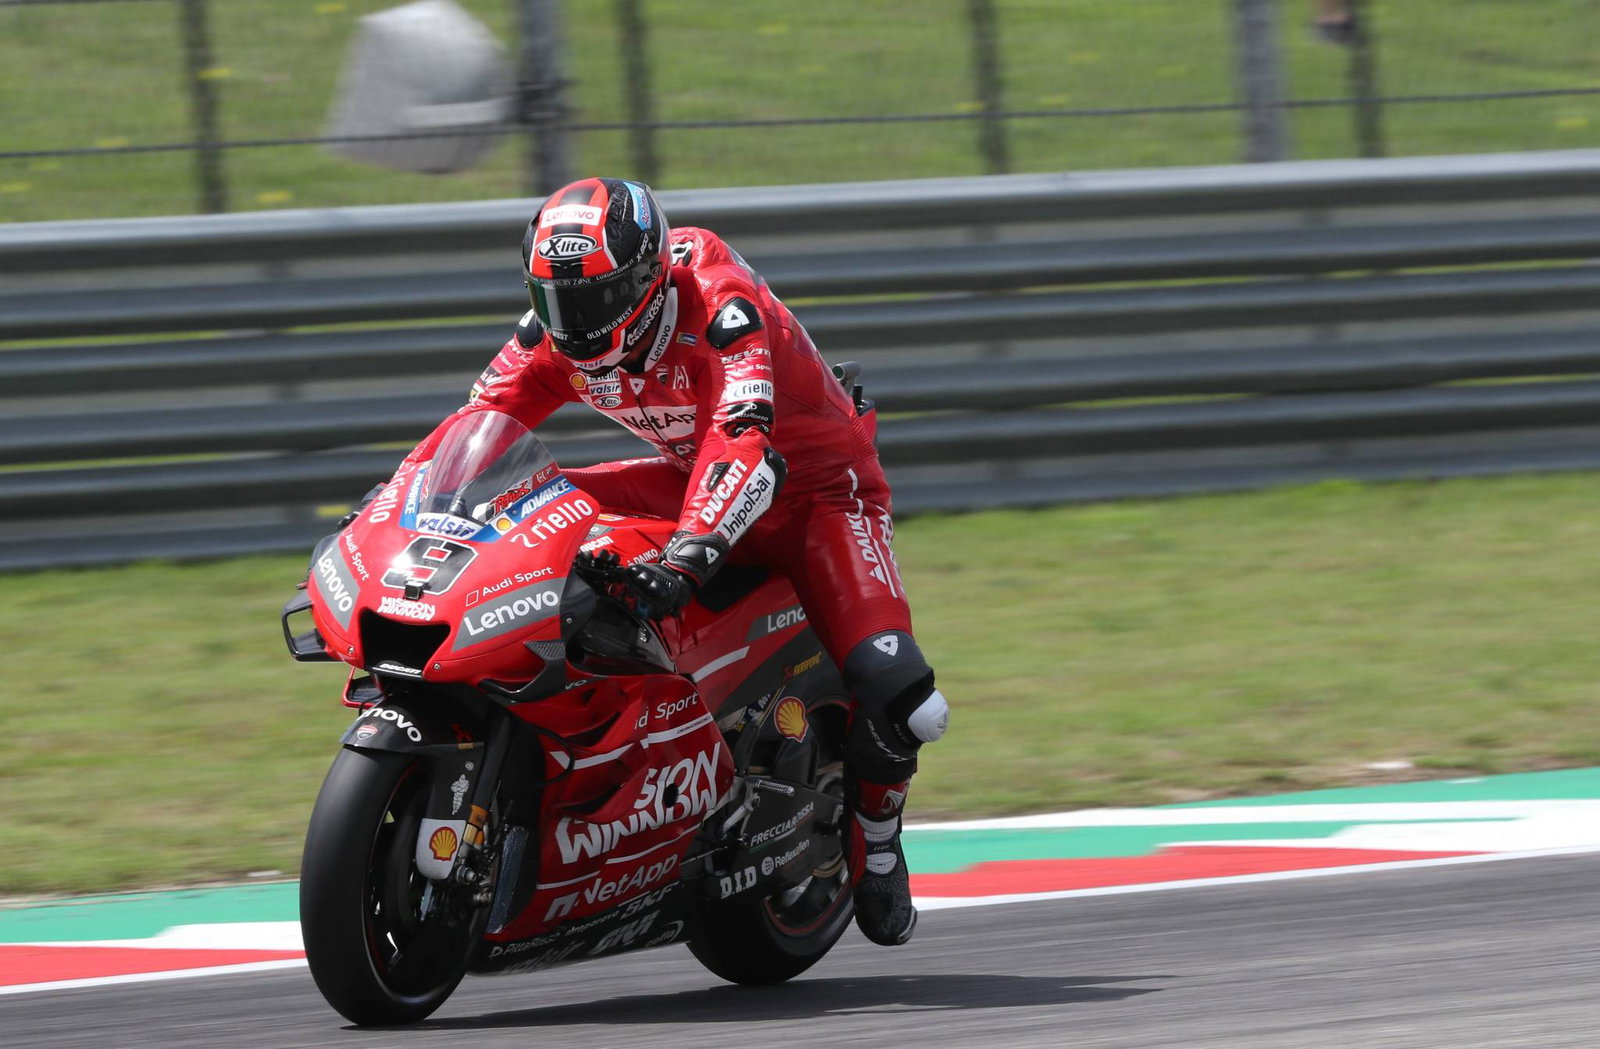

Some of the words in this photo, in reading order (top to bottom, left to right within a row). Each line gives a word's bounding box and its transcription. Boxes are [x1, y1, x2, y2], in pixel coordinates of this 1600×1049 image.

[546, 208, 595, 222] Lenovo
[544, 238, 589, 256] X-lite
[587, 331, 600, 340] OLD
[650, 324, 671, 362] Lenovo
[591, 384, 621, 395] valsir
[742, 382, 772, 396] riello
[521, 478, 570, 519] ADVANCE
[700, 458, 748, 525] DUCATI
[531, 499, 593, 540] riello
[717, 473, 771, 541] UnipolSai
[419, 515, 476, 538] valsir
[344, 533, 355, 554] Audi
[351, 552, 369, 582] Sport
[380, 535, 479, 595] 9
[633, 548, 659, 565] DAIKO
[318, 547, 353, 612] Lenovo
[482, 578, 512, 596] Audi
[514, 566, 554, 584] Sport
[464, 590, 559, 636] Lenovo
[379, 663, 422, 675] DUCATI
[655, 692, 699, 720] Sport
